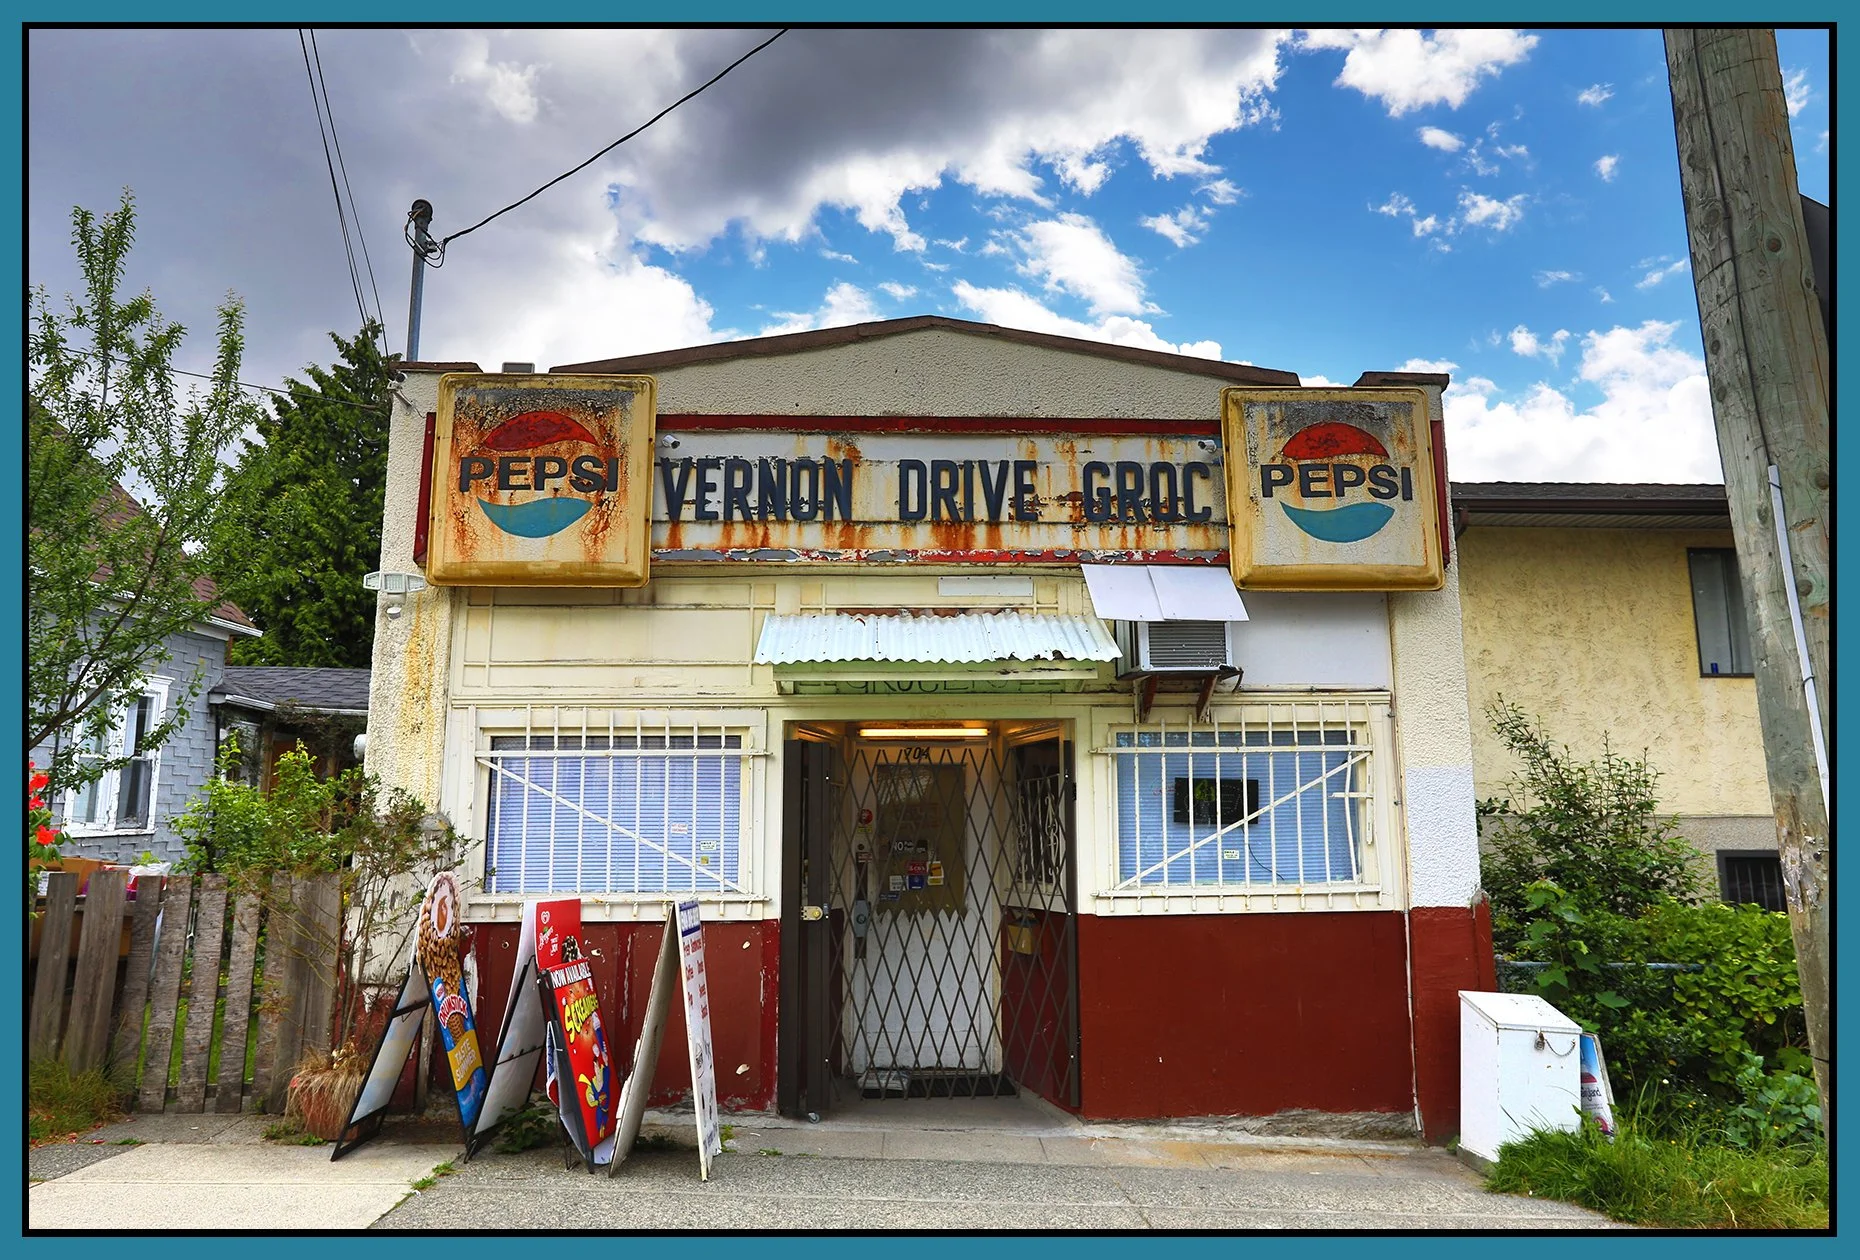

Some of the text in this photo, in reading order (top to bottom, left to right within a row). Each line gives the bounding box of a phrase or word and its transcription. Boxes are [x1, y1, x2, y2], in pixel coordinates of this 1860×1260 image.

[459, 455, 619, 493] PEPSI
[661, 457, 1212, 522] VERNON DRIVE GROC
[1260, 463, 1414, 501] PEPSI
[550, 961, 592, 989] NOW AVAILABLE
[455, 1038, 471, 1065] TASTE
